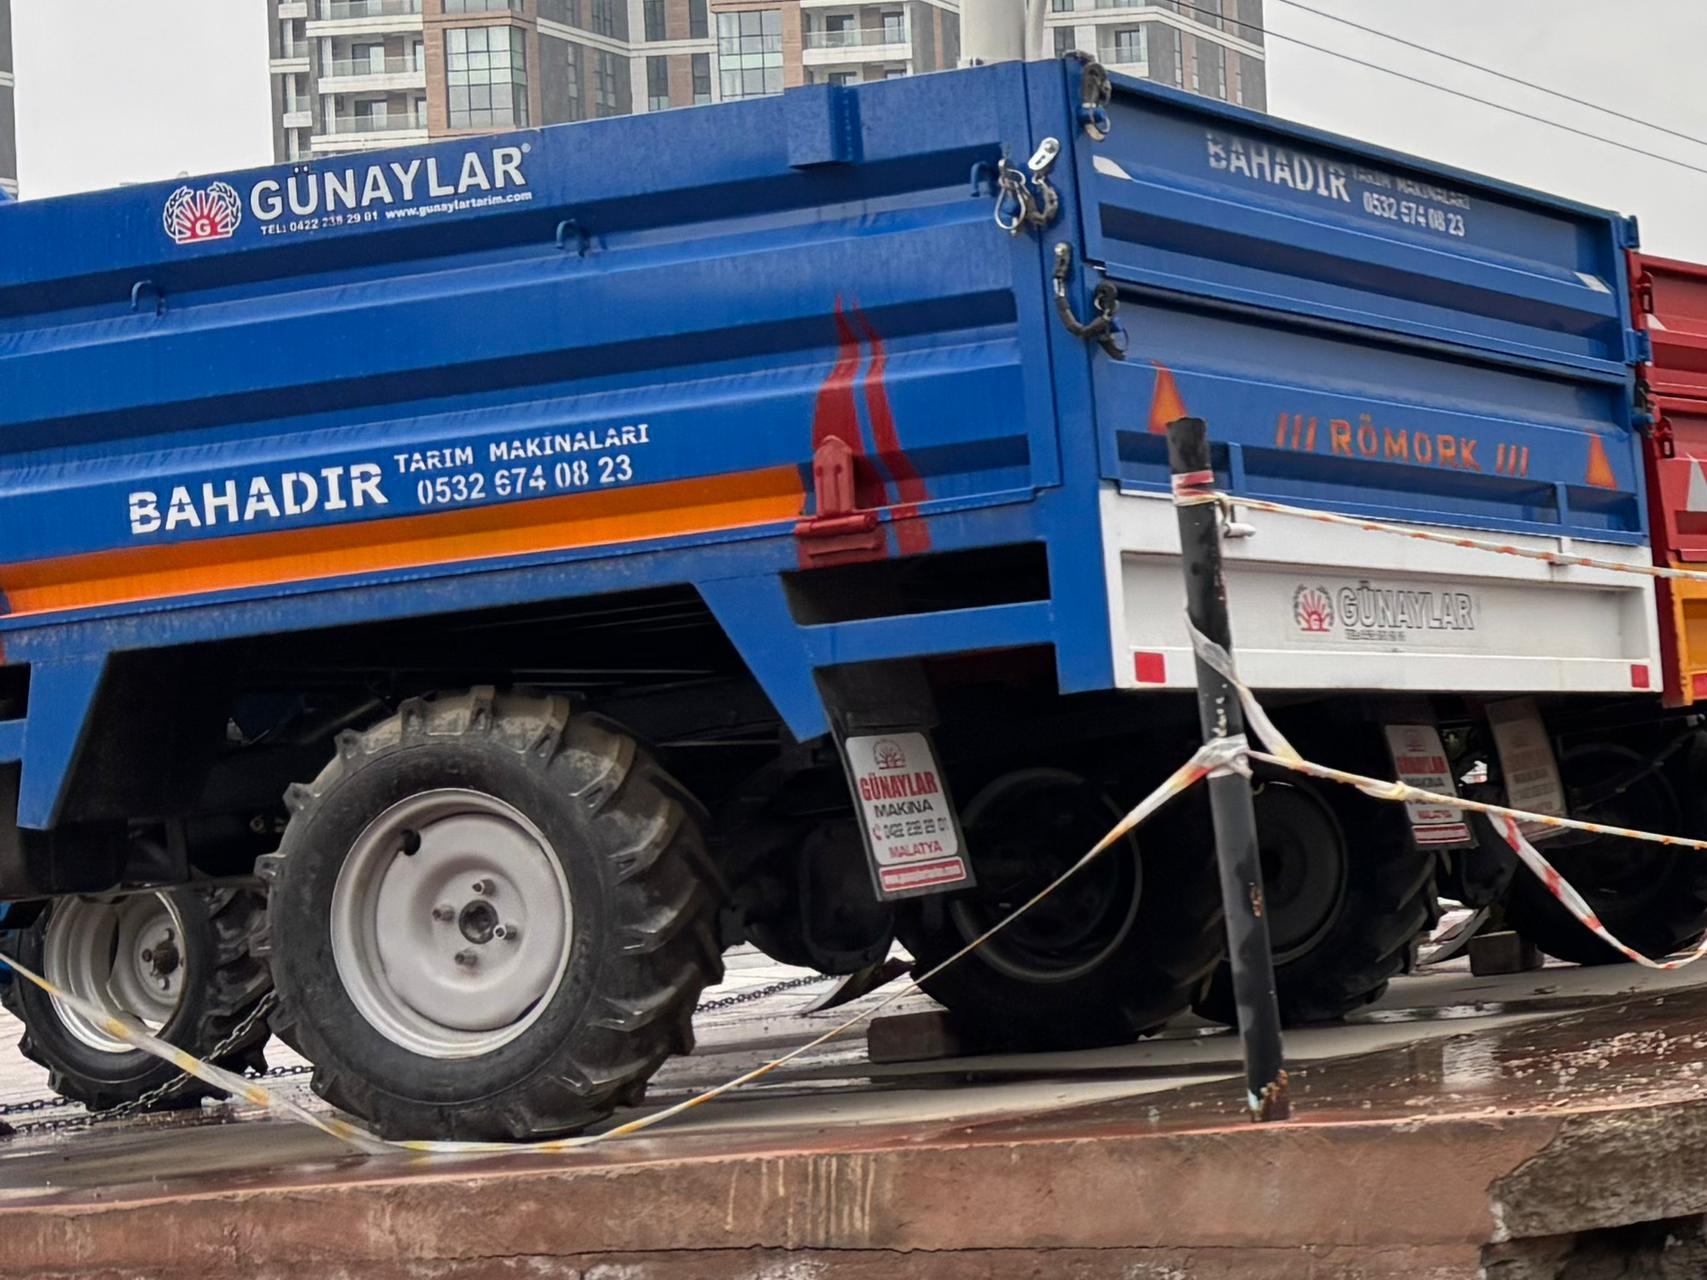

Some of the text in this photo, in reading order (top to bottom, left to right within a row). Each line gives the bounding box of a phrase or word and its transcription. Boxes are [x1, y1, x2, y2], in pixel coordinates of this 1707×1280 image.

[250, 146, 527, 220] GÜNAYLAR
[1206, 131, 1352, 203] BAHADIR
[260, 223, 287, 236] TEL:
[289, 220, 320, 234] 0422
[346, 214, 363, 226] 29
[385, 190, 533, 220] www.gunaylartarim.com
[1363, 191, 1399, 220] 0532
[1446, 212, 1466, 238] 23
[393, 424, 650, 475] TARIM MAKINALARI
[1329, 413, 1483, 474] RÖMORK
[127, 462, 390, 535] BAHADIR
[416, 454, 634, 505] 0532 674 08 23
[1335, 579, 1476, 631] GÜNAYLAR
[859, 770, 939, 802] GÜNAYLAR
[887, 839, 944, 859] MALATYA
